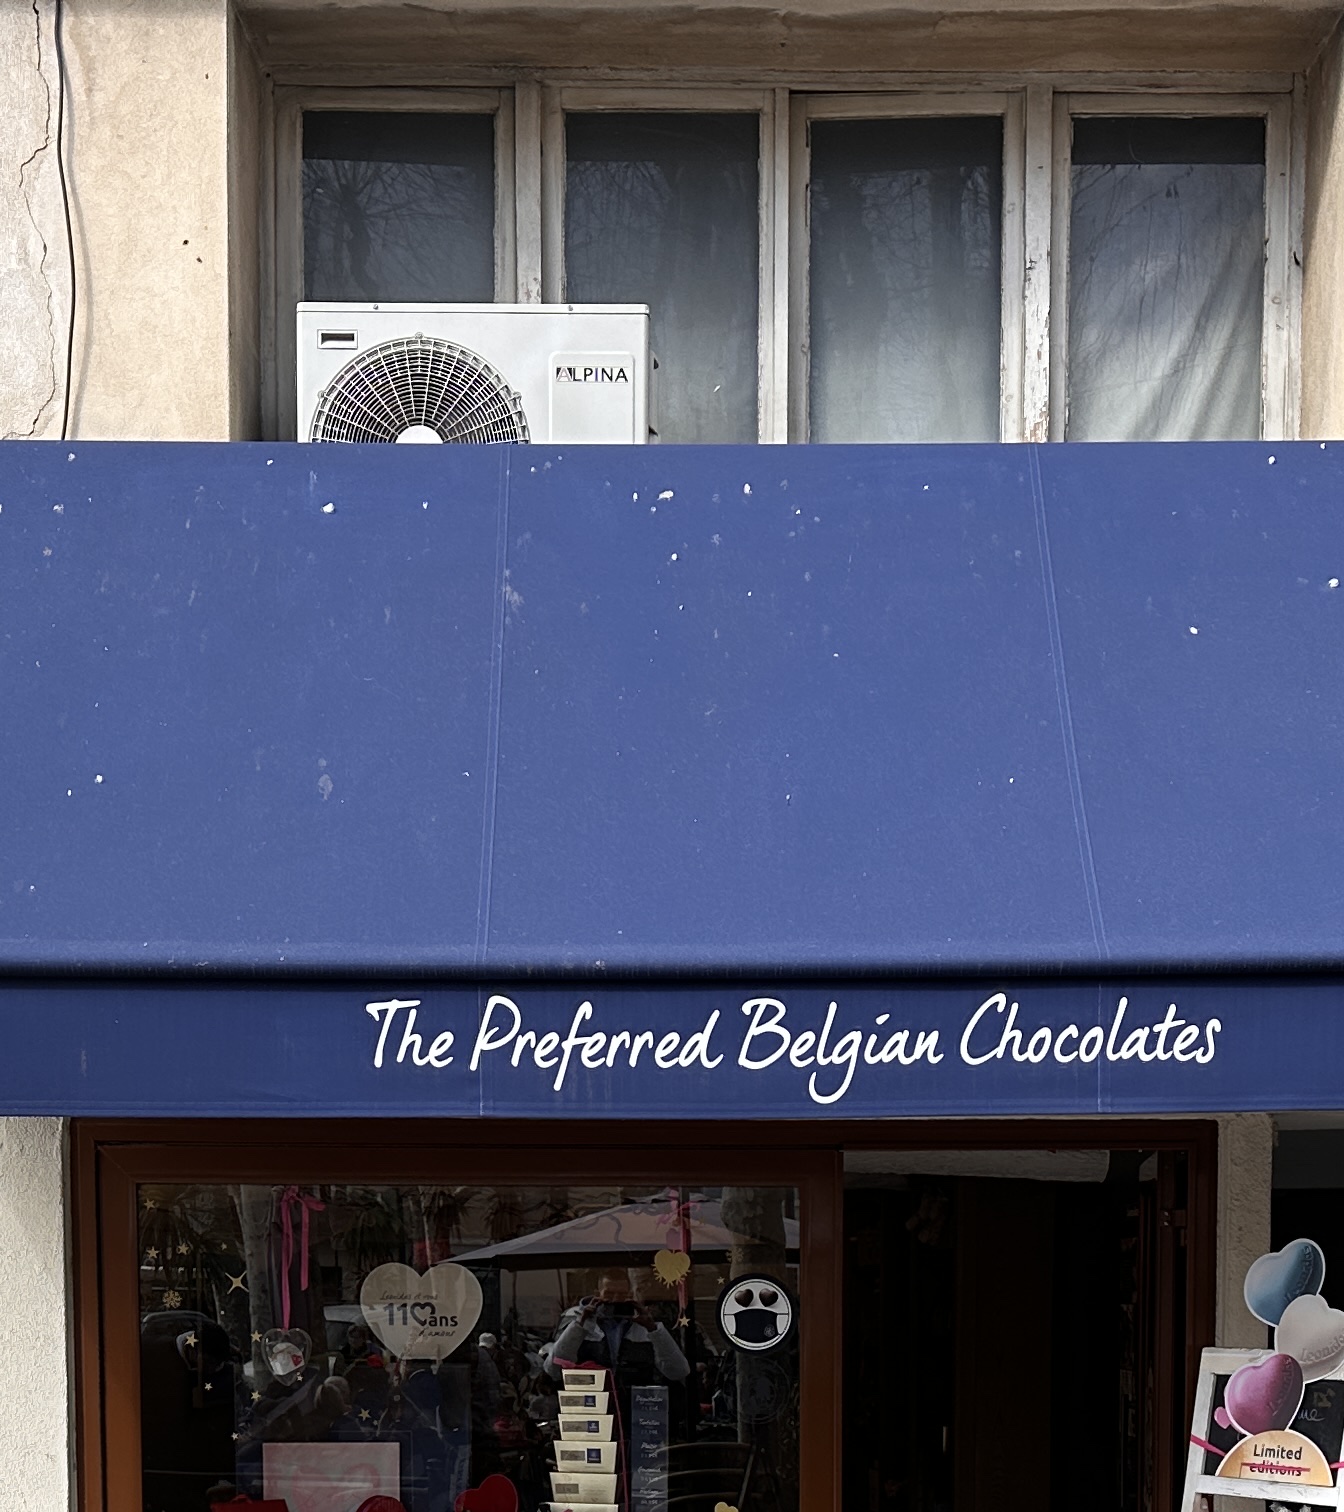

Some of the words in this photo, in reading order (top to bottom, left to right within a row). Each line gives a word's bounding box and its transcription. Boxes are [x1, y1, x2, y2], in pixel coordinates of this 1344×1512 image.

[555, 366, 629, 383] ALPINA
[365, 999, 454, 1068] The
[469, 995, 724, 1092] Preferred
[737, 997, 945, 1104] Belgian
[960, 992, 1222, 1066] Chocolates
[1253, 1443, 1303, 1461] Limited
[1249, 1459, 1303, 1478] editions
